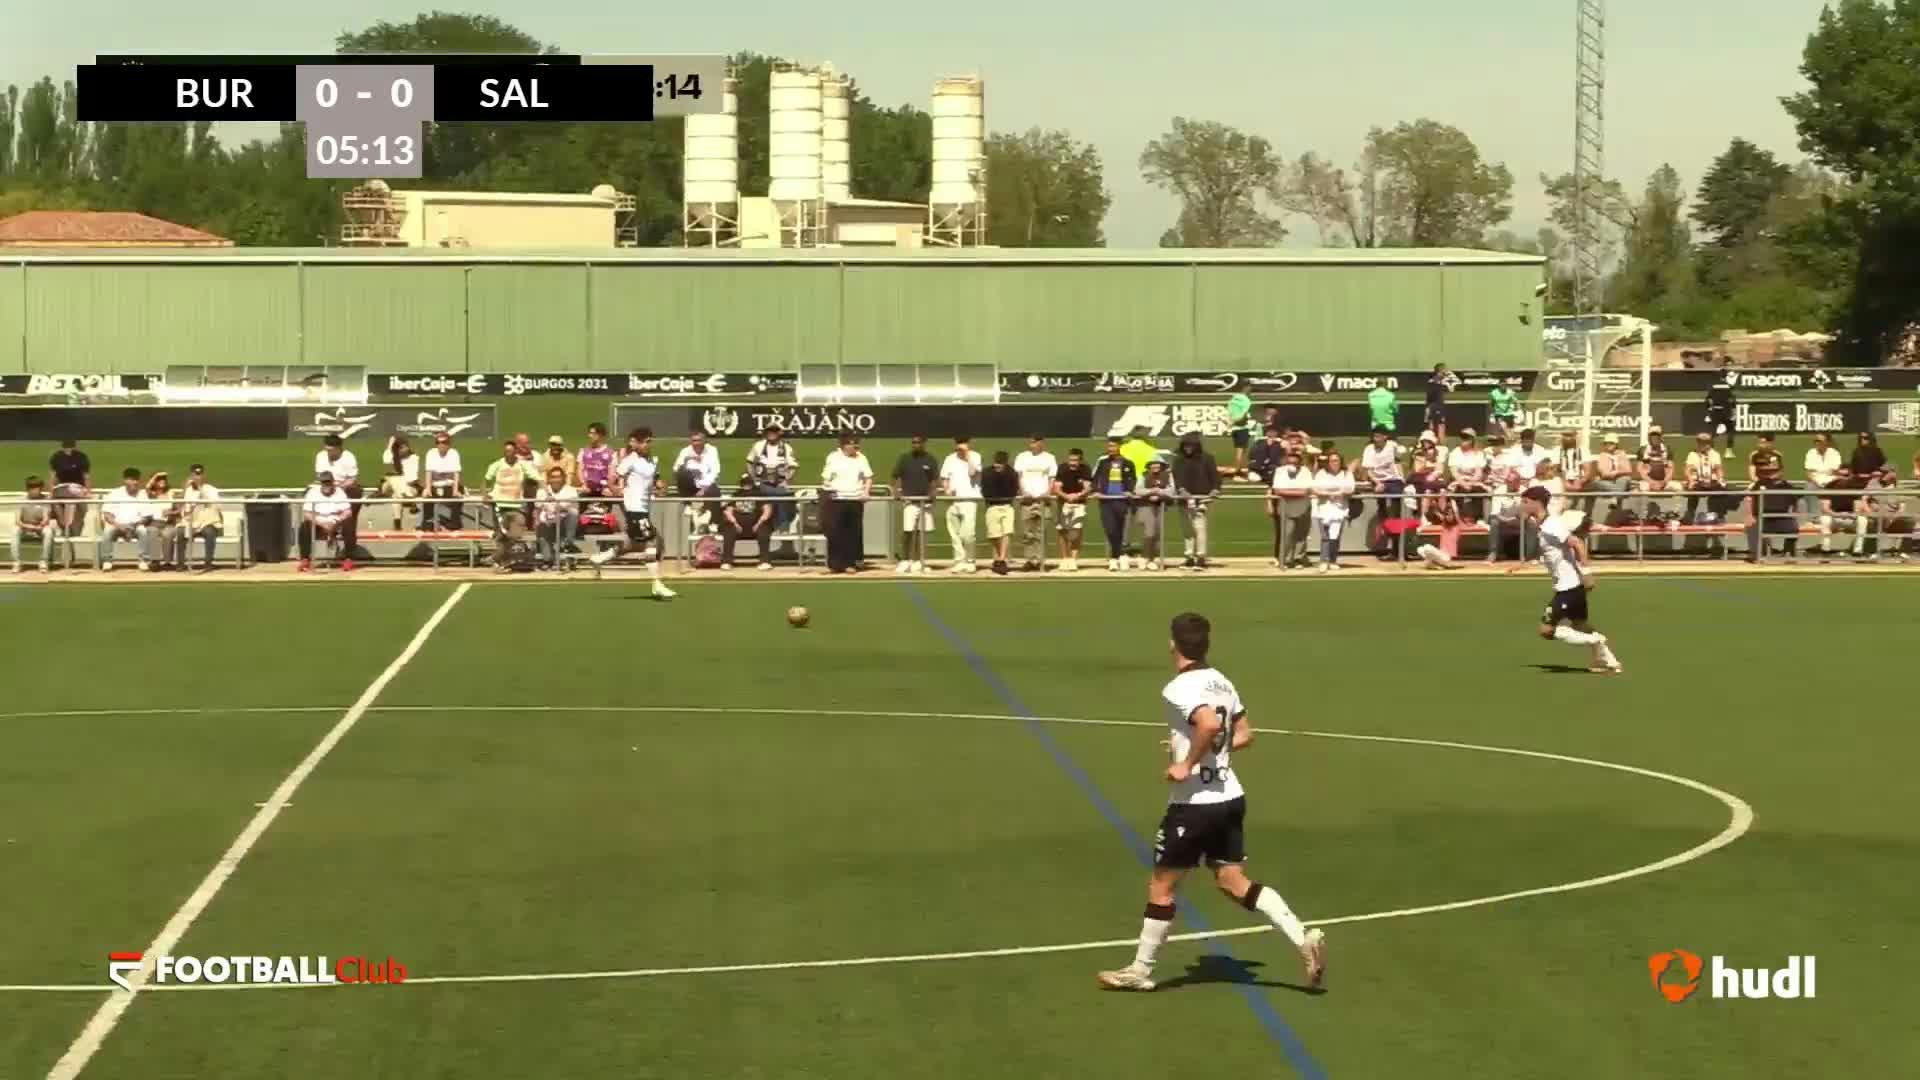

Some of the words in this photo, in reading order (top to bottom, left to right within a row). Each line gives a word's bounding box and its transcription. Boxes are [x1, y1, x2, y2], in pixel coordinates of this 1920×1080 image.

[525, 377, 574, 389] BURGOS
[577, 377, 608, 389] 2031
[1337, 376, 1399, 389] macrn
[1741, 374, 1801, 387] macron
[752, 413, 876, 432] TRAJANO
[1735, 403, 1790, 432] HIERROS
[1795, 403, 1844, 432] BURGOS
